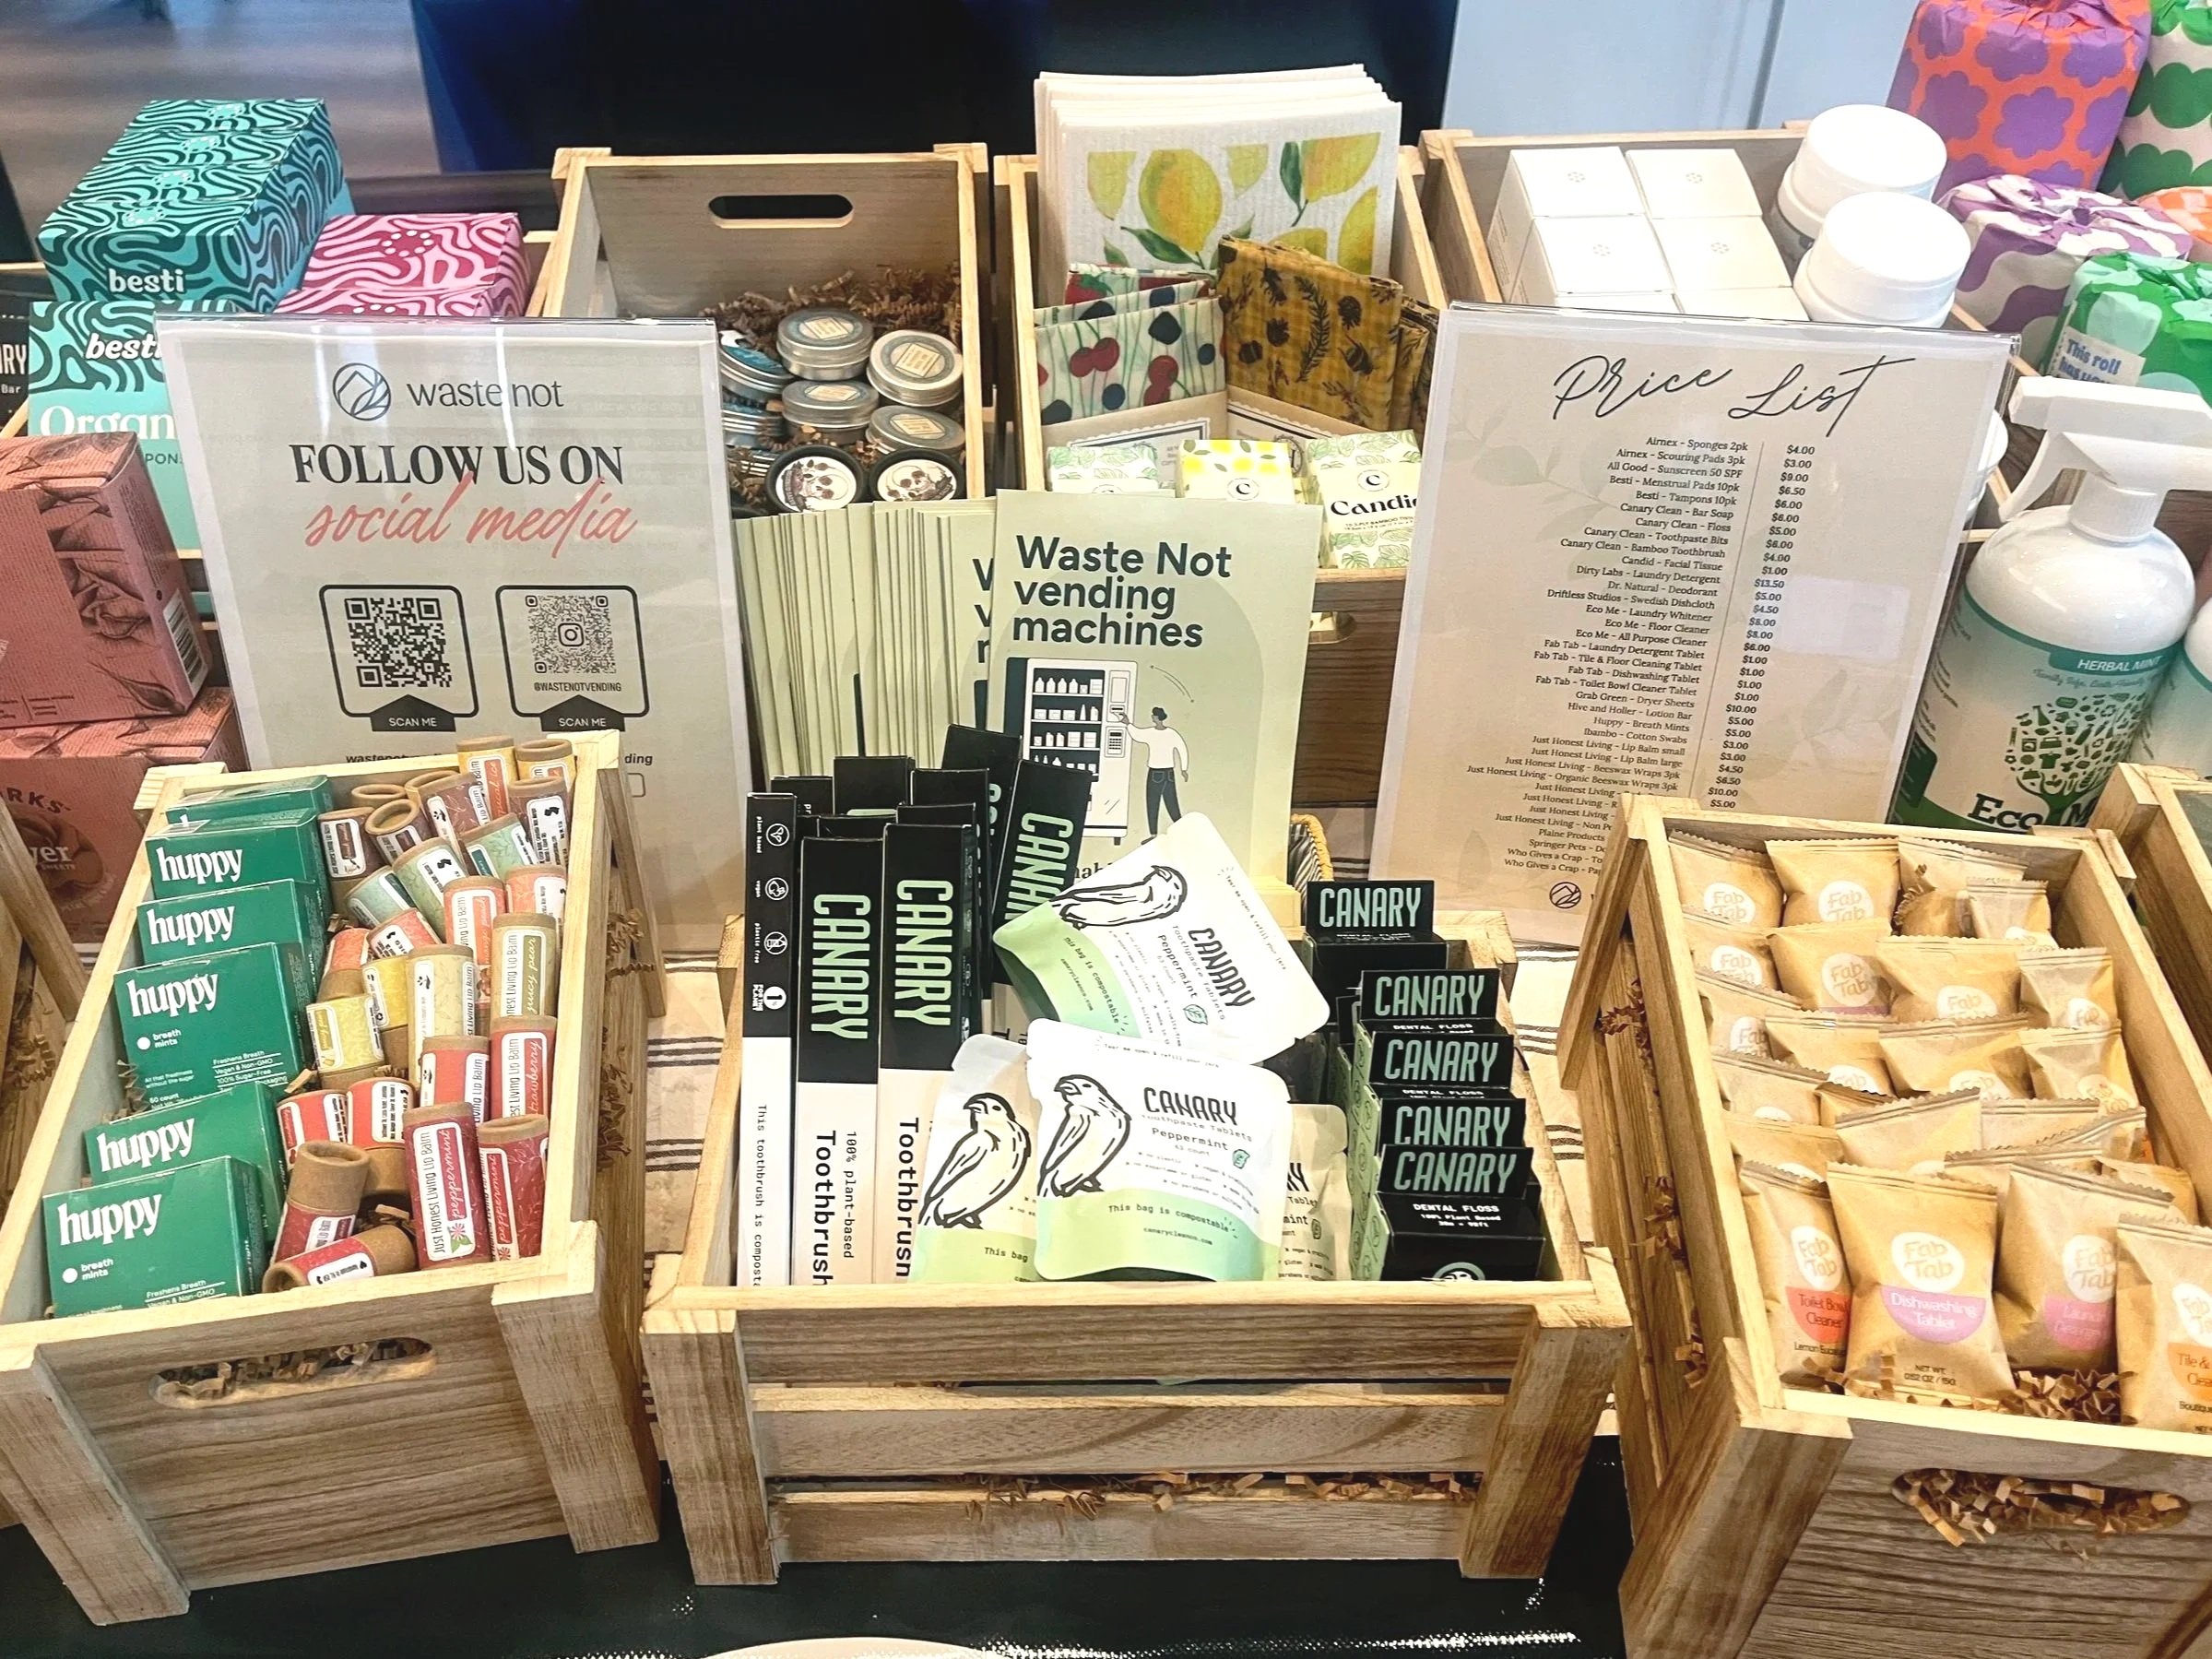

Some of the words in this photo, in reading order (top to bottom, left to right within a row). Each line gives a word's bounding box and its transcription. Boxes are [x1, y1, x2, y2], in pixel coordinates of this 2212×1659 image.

[108, 268, 184, 293] besti
[2066, 338, 2091, 363] This
[2091, 355, 2122, 375] roll
[407, 380, 503, 408] waste
[512, 380, 564, 408] not
[1553, 355, 1733, 421] Price
[1728, 355, 1916, 438] List
[40, 406, 175, 440] Organ
[1646, 437, 1677, 446] Airnex
[1687, 440, 1728, 451] Sponges
[1730, 442, 1748, 451] 2pk
[1787, 445, 1815, 455] $4.00
[289, 444, 482, 485] FOLLOW
[493, 445, 550, 485] US
[561, 445, 623, 485] ON
[1616, 448, 1648, 458] Airnex
[1657, 451, 1699, 464] Scouring
[1702, 454, 1724, 463] Pads
[1729, 456, 1745, 466] 3pk
[1784, 459, 1812, 468] $3.00
[1607, 462, 1620, 470] All
[1623, 463, 1648, 472] Good
[1709, 468, 1721, 477] 50
[1724, 469, 1743, 479] SPF
[1780, 472, 1808, 482] $9.00
[1610, 476, 1632, 485] Besti
[1642, 478, 1691, 489] Menstrual
[1693, 480, 1715, 490] Pads
[1718, 482, 1740, 492] 10pk
[1779, 486, 1805, 495] $6.50
[1636, 491, 1659, 500] Besti
[1669, 492, 1712, 504] Tampons
[1715, 495, 1736, 506] 10pk
[1775, 500, 1802, 509] $6.00
[305, 471, 473, 547] social
[466, 476, 637, 559] media
[1620, 504, 1653, 515] Canary
[1656, 504, 1682, 515] Clean
[1693, 508, 1709, 517] Bar
[1710, 510, 1733, 520] Soap
[1584, 527, 1617, 539] Canary
[1619, 529, 1645, 539] Clean
[1656, 532, 1709, 544] Toothpaste
[1711, 536, 1728, 545] Bits
[1636, 517, 1669, 529] Canary
[1671, 520, 1697, 529] Clean
[1708, 523, 1731, 532] Floss
[1768, 527, 1796, 536] $5.00
[1016, 535, 1143, 573] Waste
[1156, 541, 1232, 577] Not
[1560, 538, 1593, 550] Canary
[1595, 540, 1621, 551] Clean
[1631, 543, 1668, 554] Bamboo
[1671, 546, 1725, 558] Toothbrush
[1763, 552, 1791, 563] $4.00
[1622, 556, 1654, 566] Candid
[1664, 559, 1691, 569] Facial
[1693, 562, 1723, 571] Tissue
[1762, 566, 1788, 575] $1.00
[1014, 575, 1176, 620] vending
[1608, 581, 1623, 590] Dr.
[1625, 582, 1659, 592] Natural
[1669, 586, 1718, 597] Deodorant
[1012, 611, 1203, 647] machines
[1605, 619, 1623, 628] Eco
[1625, 620, 1639, 629] Me
[1648, 622, 1672, 632] Floor
[1674, 624, 1709, 634] Cleaner
[1568, 666, 1584, 674] Fab
[1586, 668, 1603, 676] Tab
[1612, 670, 1670, 682] Dishwashing
[1672, 674, 1700, 684] Tablet
[2077, 658, 2131, 671] HERBAL
[2132, 656, 2164, 670] MINT
[1726, 705, 1757, 715] $10.00
[388, 717, 412, 728] SCAN
[415, 717, 437, 728] ME
[559, 717, 582, 728] SCAN
[584, 717, 607, 728] ME
[1594, 717, 1623, 728] Huppy
[1633, 720, 1662, 729] Breath
[1665, 722, 1690, 732] Mints
[1622, 743, 1635, 752] Lip
[1638, 745, 1659, 753] Balm
[156, 847, 242, 885] huppy
[1004, 812, 1073, 919] CANA
[1508, 848, 1527, 857] Who
[1529, 850, 1552, 859] Gives
[1562, 854, 1582, 863] Crap
[1319, 887, 1421, 928] CANARY
[146, 905, 235, 946] huppy
[894, 880, 953, 1026] CANARY
[810, 894, 870, 1039] CANARY
[1158, 934, 1199, 1000] Peppermint
[1188, 928, 1256, 1007] CANARY
[125, 973, 219, 1018] huppy
[1375, 975, 1485, 1016] CANARY
[153, 1029, 182, 1041] breath
[154, 1038, 178, 1049] mints
[1385, 1039, 1498, 1083] CANARY
[757, 1104, 767, 1132] This
[1143, 1087, 1237, 1126] CANARY
[1394, 1106, 1511, 1146] CANARY
[96, 1118, 195, 1172] huppy
[846, 1132, 857, 1162] 100%
[1152, 1127, 1228, 1151] Peppermint
[439, 1129, 463, 1219] peppermint
[754, 1139, 766, 1207] toothbrush
[1393, 1151, 1517, 1193] CANARY
[488, 1154, 509, 1244] peppermint
[811, 1131, 836, 1286] Toothbrush
[1413, 1203, 1458, 1212] DENTAL
[1462, 1204, 1500, 1213] FLOSS
[57, 1194, 162, 1246] huppy
[754, 1215, 763, 1227] is
[843, 1169, 856, 1259] plant-based
[1108, 1203, 1130, 1213] This
[1137, 1203, 1153, 1214] bag
[1176, 1210, 1229, 1233] compostable
[751, 1234, 762, 1286] compost
[984, 1247, 1007, 1258] This
[1011, 1251, 1028, 1263] bag
[1890, 1292, 1978, 1319] Dishwashing
[1914, 1311, 1956, 1329] Tablet
[2177, 1353, 2197, 1367] Tile
